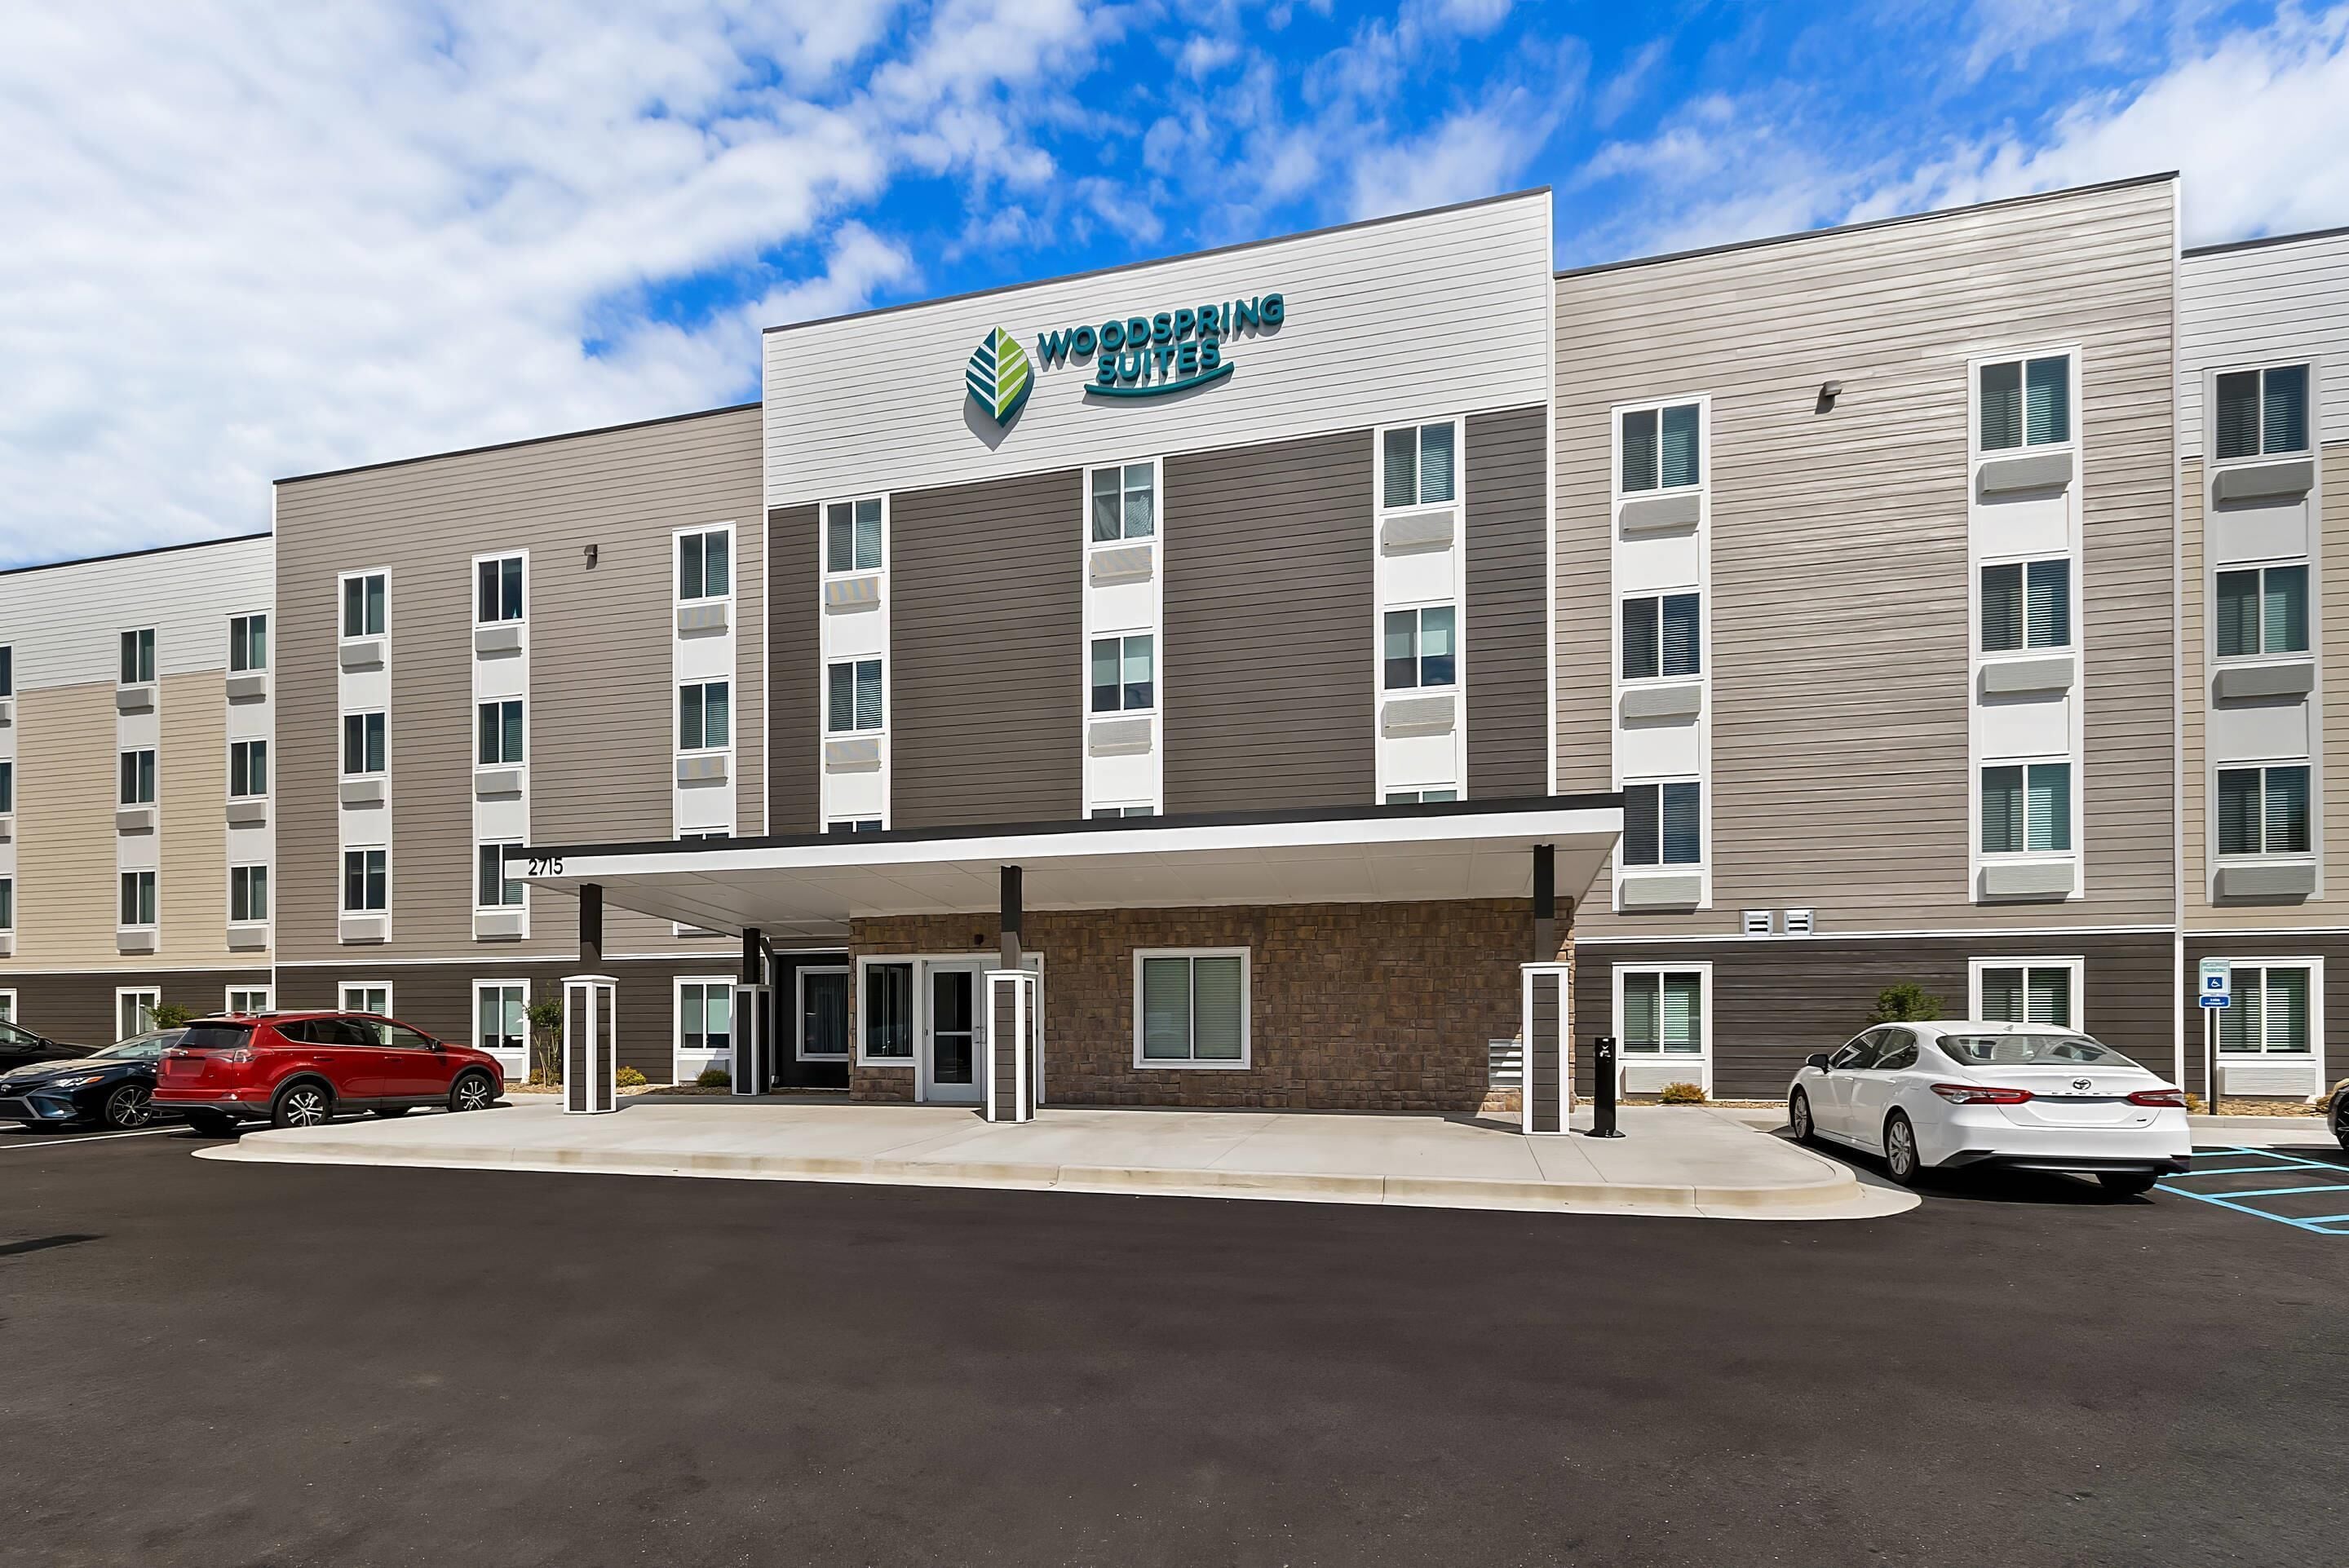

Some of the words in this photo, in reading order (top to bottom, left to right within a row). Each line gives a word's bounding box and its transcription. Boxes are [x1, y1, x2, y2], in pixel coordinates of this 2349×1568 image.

[1037, 293, 1285, 363] WOODSPRING
[1098, 338, 1221, 384] SUITES
[529, 857, 563, 876] 2715
